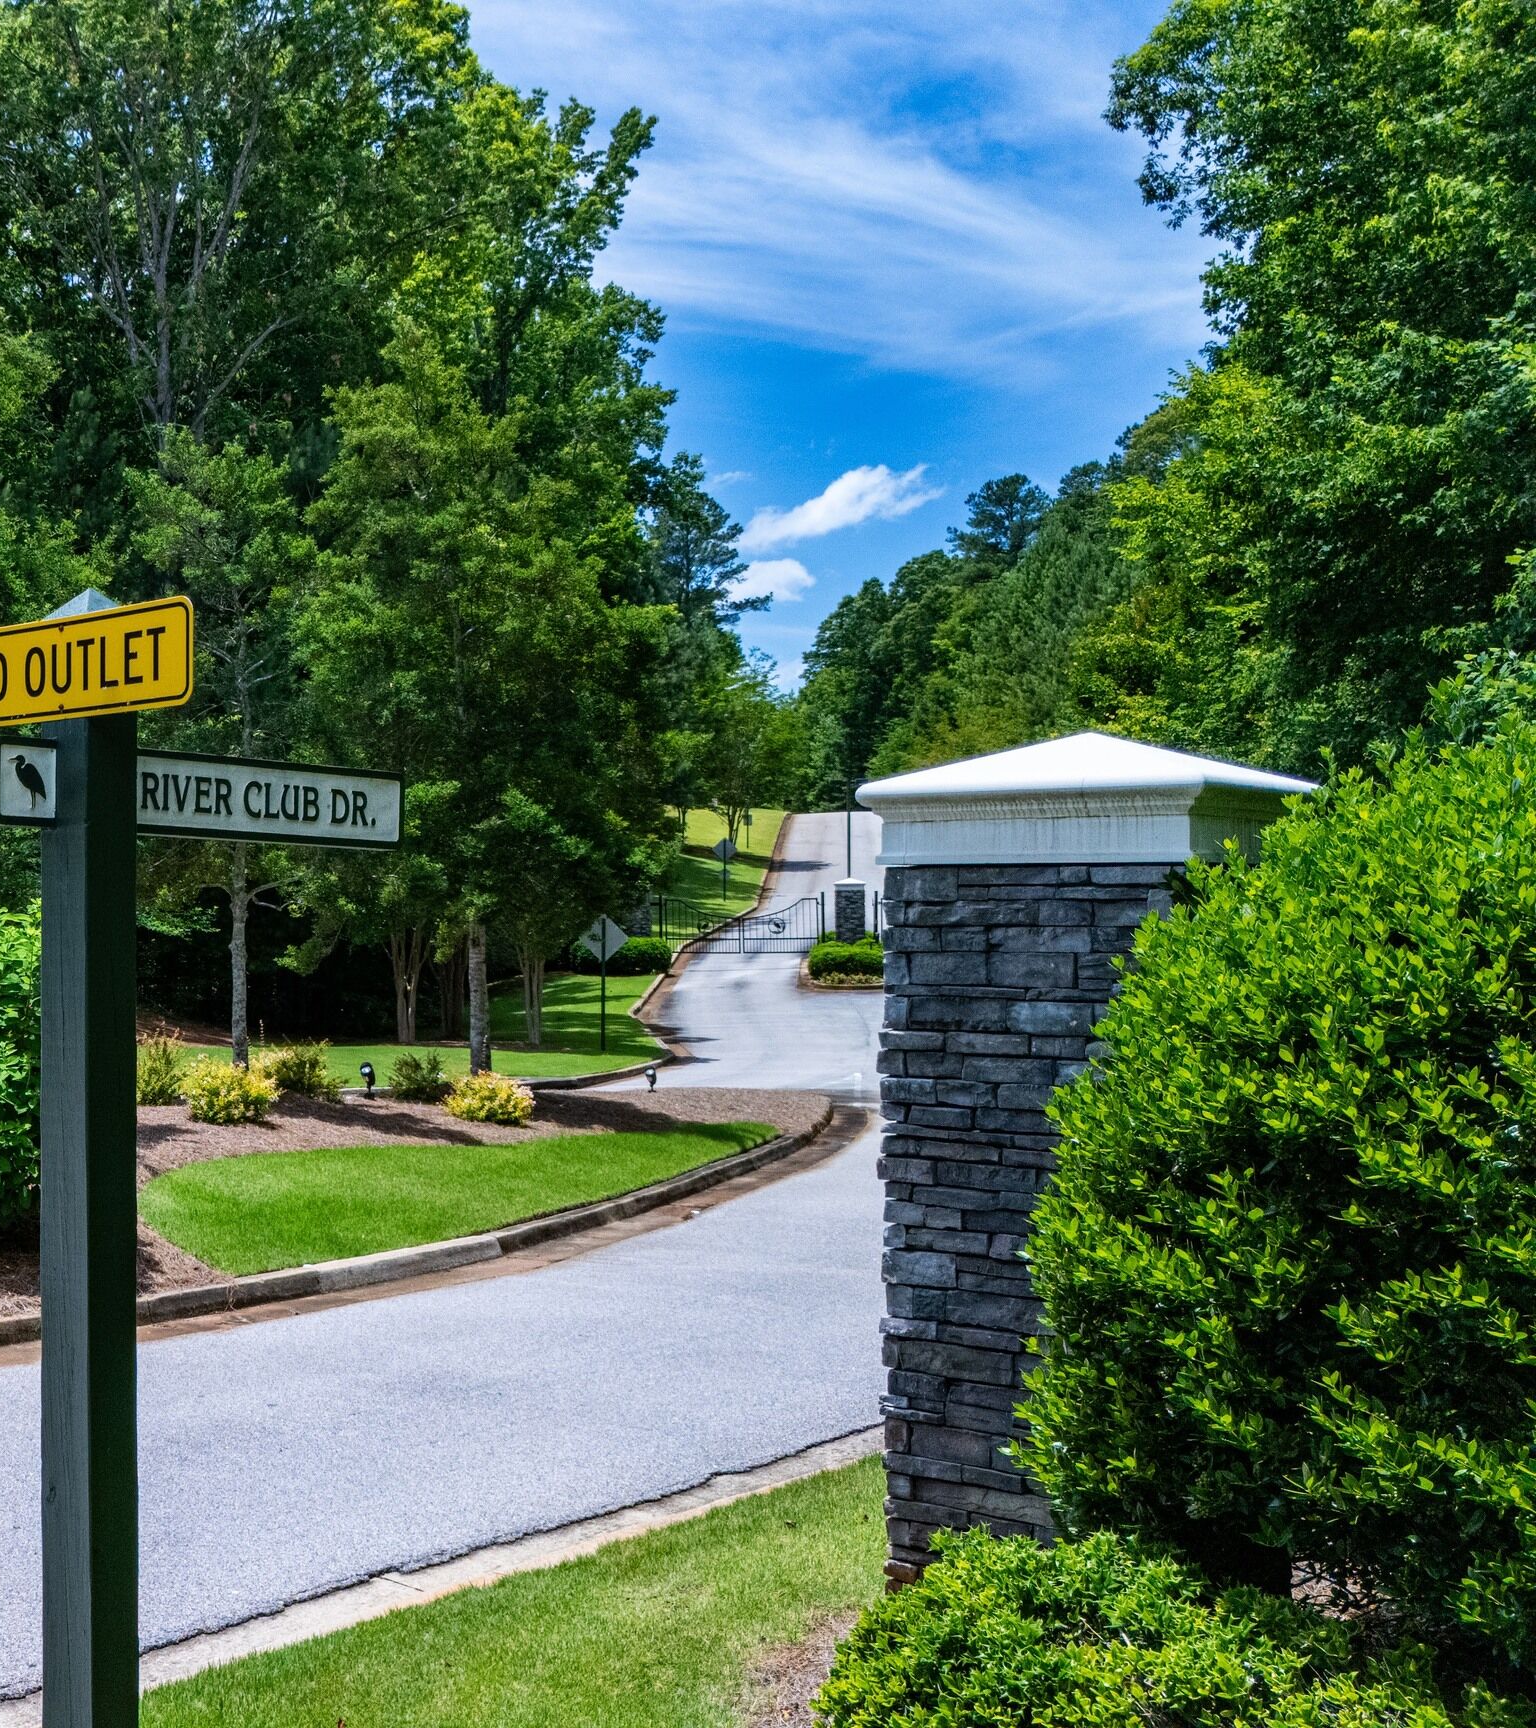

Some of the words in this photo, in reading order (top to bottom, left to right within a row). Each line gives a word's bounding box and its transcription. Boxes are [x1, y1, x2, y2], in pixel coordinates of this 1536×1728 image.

[24, 626, 167, 698] OUTLET
[140, 771, 232, 816] RIVER
[243, 780, 320, 821] CLUB
[330, 788, 376, 827] DR.
